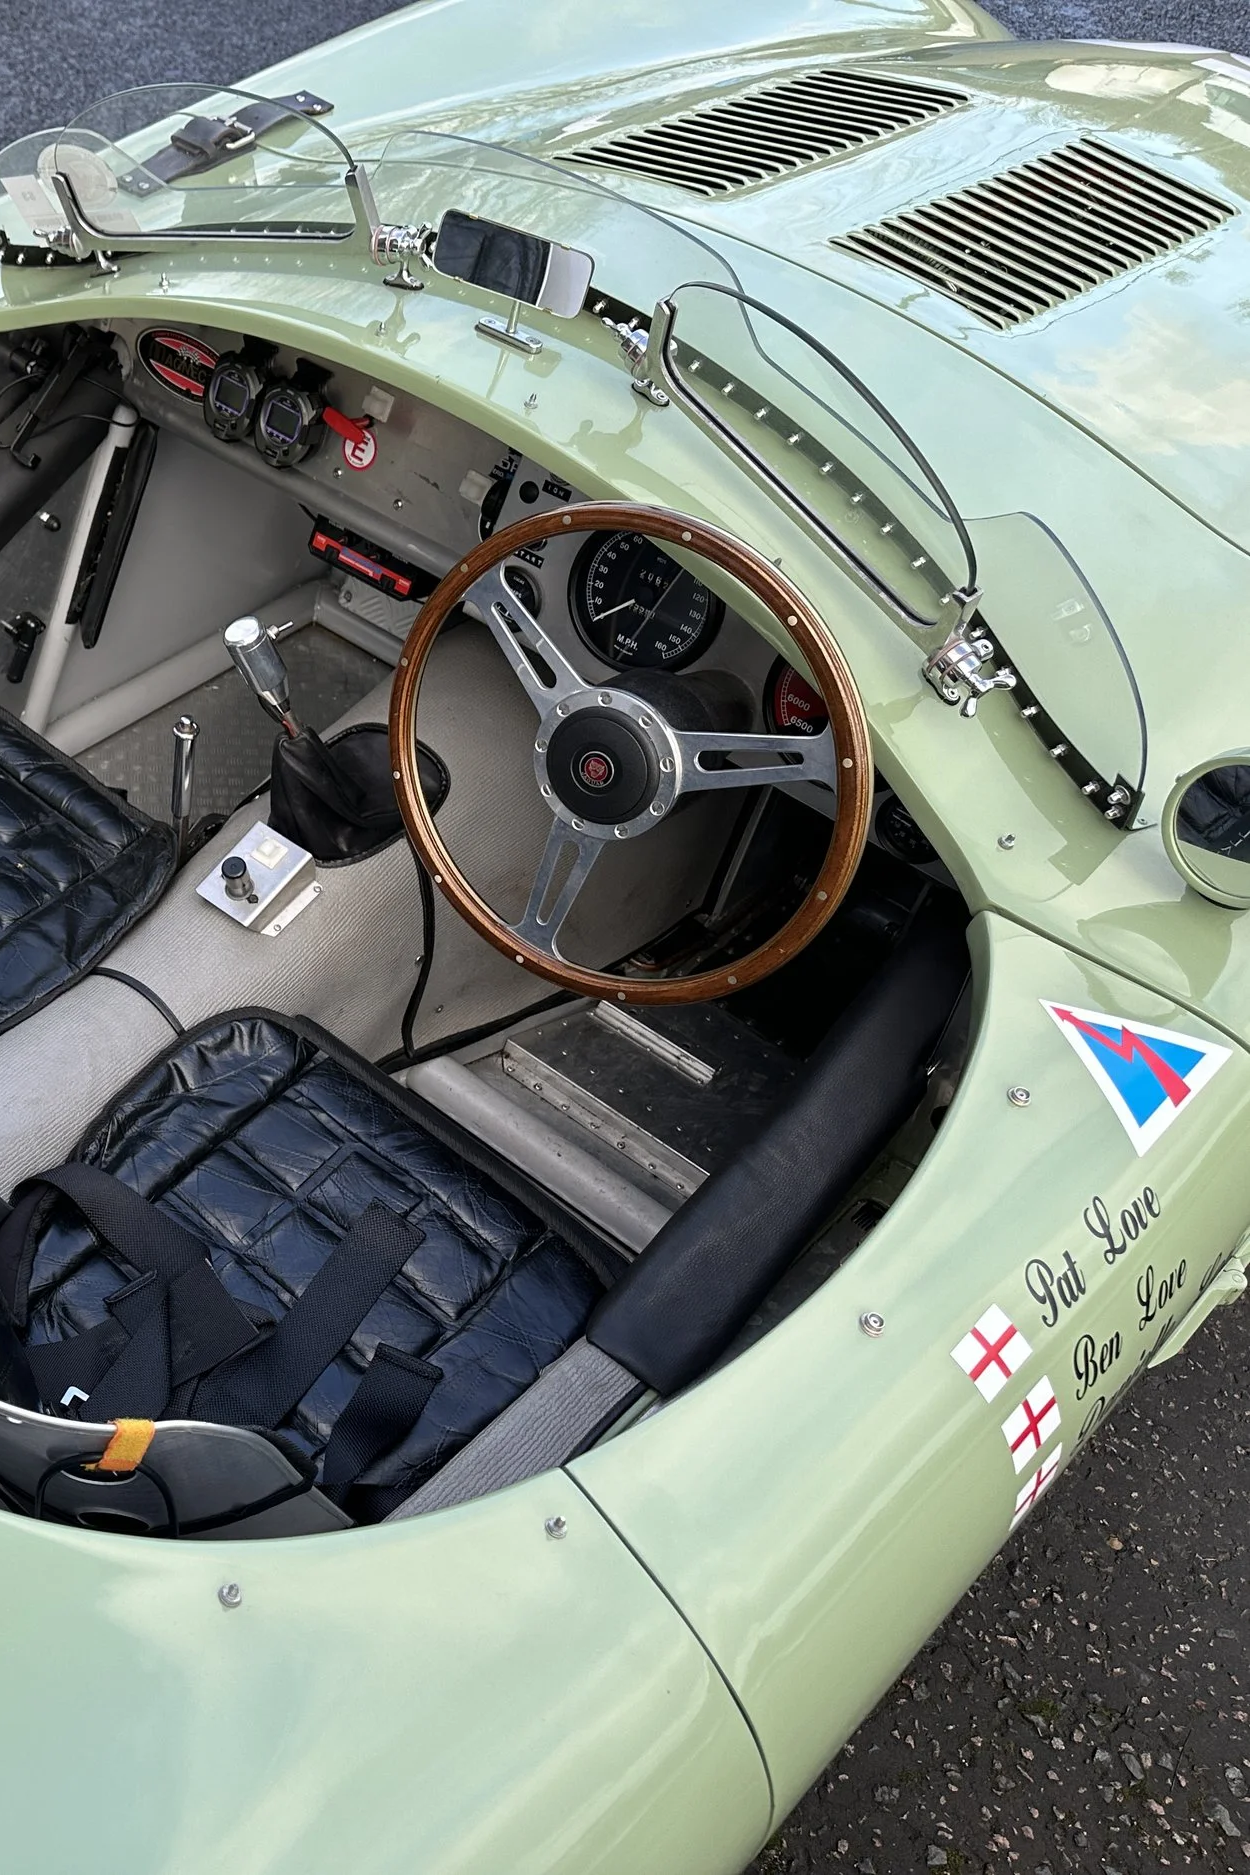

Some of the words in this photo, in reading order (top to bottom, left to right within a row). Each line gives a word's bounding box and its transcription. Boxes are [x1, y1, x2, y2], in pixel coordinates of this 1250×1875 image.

[149, 340, 212, 383] MAGNEC
[633, 535, 643, 544] 60
[620, 541, 630, 551] 50
[607, 551, 617, 560] 40
[599, 564, 608, 574] 30
[594, 580, 604, 589] 20
[595, 596, 602, 605] 10
[692, 592, 705, 603] 120
[689, 609, 701, 620] 130
[680, 623, 692, 634] 140
[669, 634, 681, 645] 150
[655, 641, 667, 651] 160
[787, 693, 811, 711] 6000
[790, 715, 814, 733] 6500
[1025, 1250, 1086, 1328] Pat
[1083, 1186, 1161, 1265] Love
[1073, 1331, 1123, 1401] Ben
[1137, 1259, 1187, 1331] Love
